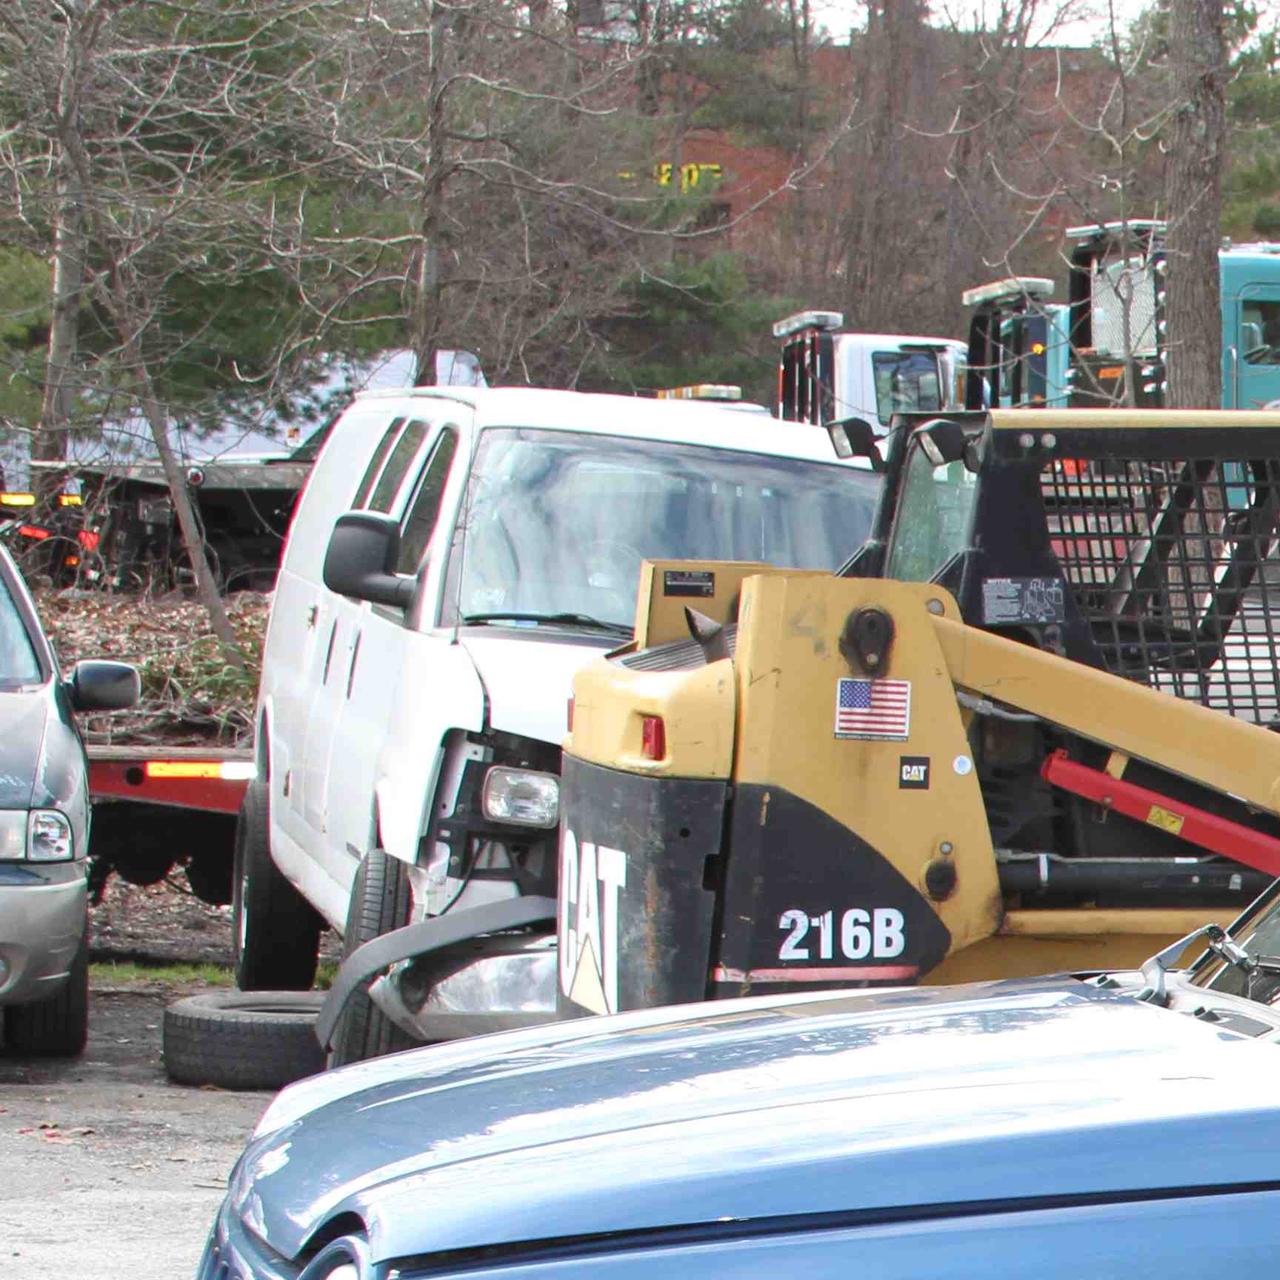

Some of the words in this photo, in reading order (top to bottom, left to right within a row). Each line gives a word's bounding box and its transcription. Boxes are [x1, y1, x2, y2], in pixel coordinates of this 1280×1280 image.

[901, 765, 928, 782] CAT
[558, 828, 627, 1015] CAT
[778, 907, 906, 961] 216B
